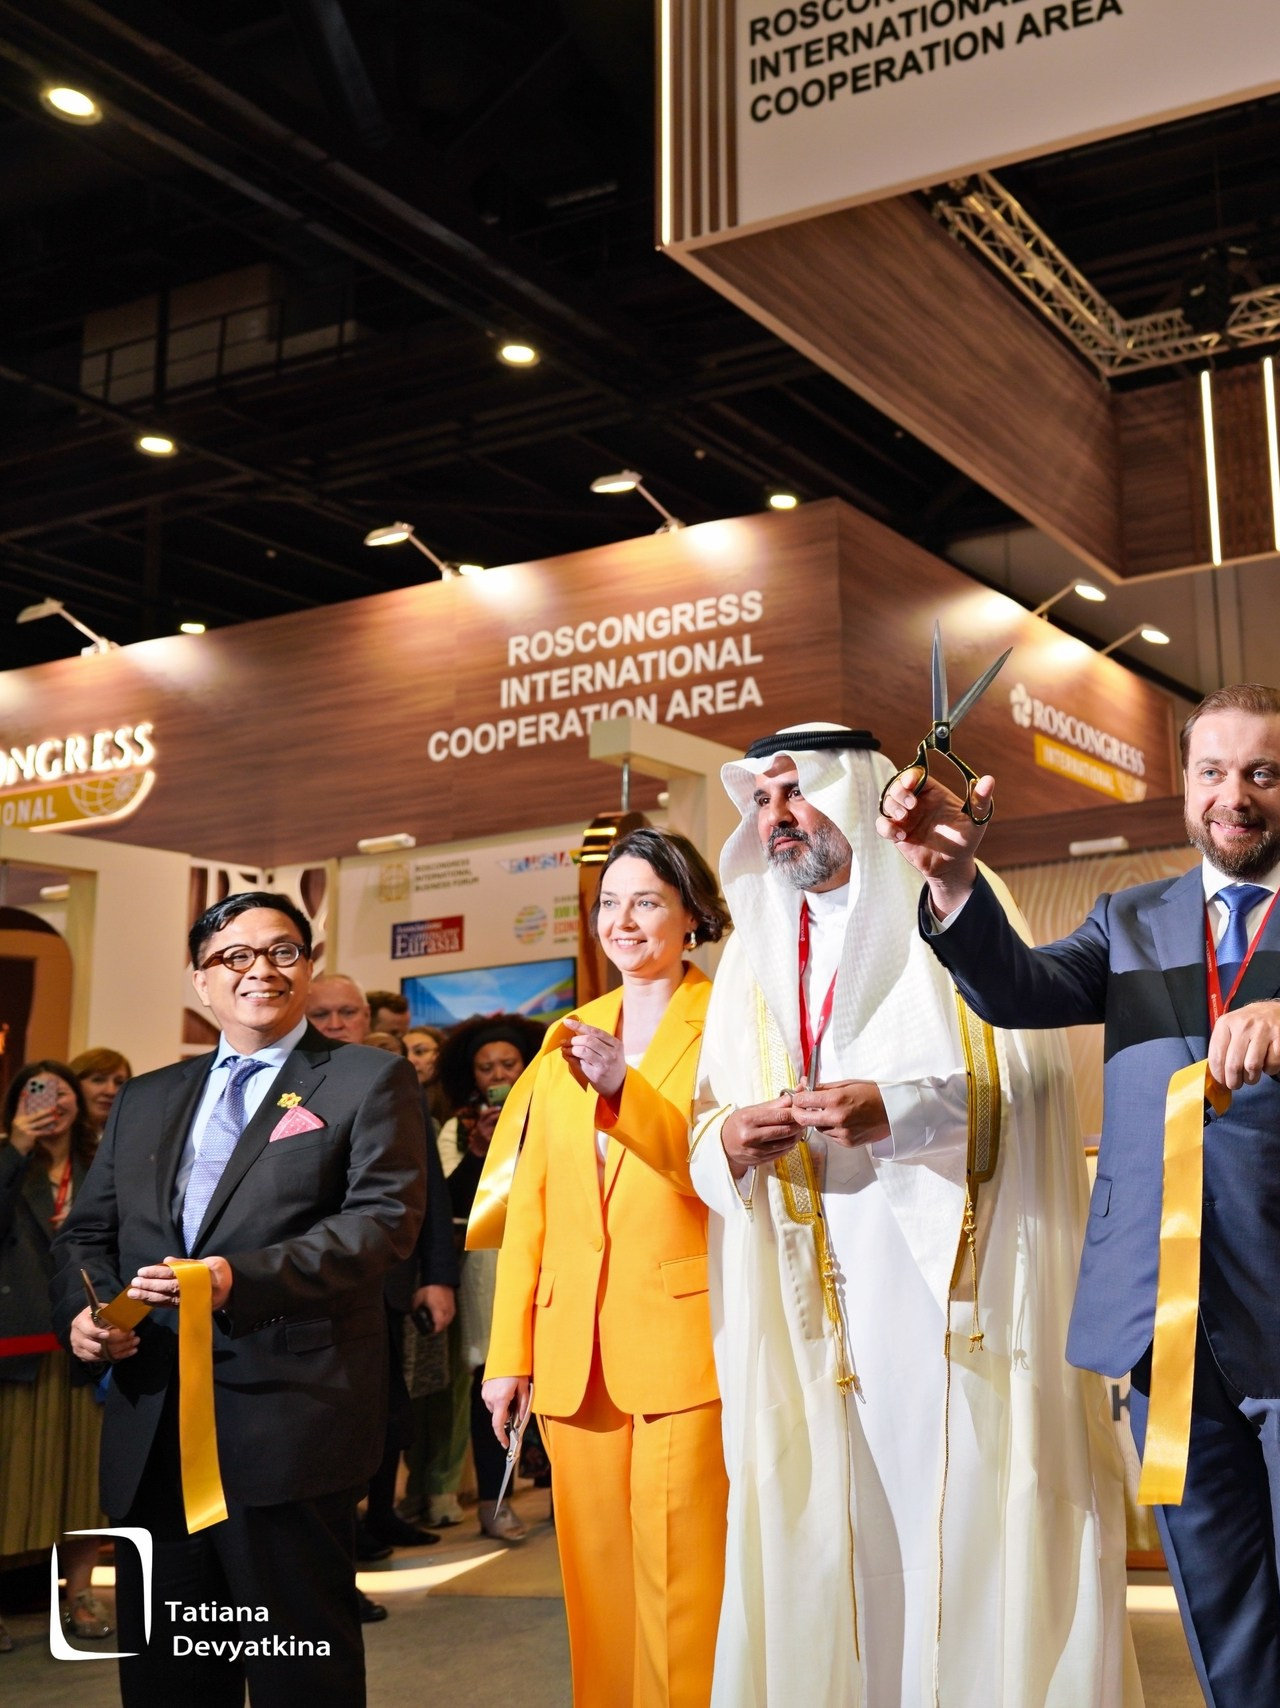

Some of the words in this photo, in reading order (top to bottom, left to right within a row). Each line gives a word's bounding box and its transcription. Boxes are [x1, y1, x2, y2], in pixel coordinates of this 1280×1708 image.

[750, 0, 1029, 85] INTERNATION
[750, 21, 1005, 123] COOPERATION
[1015, 0, 1124, 44] AREA
[508, 590, 763, 667] ROSCONGRESS
[500, 633, 763, 709] INTERNATIONAL
[665, 677, 763, 722] AREA
[1032, 699, 1146, 776] ROSCONGRESS
